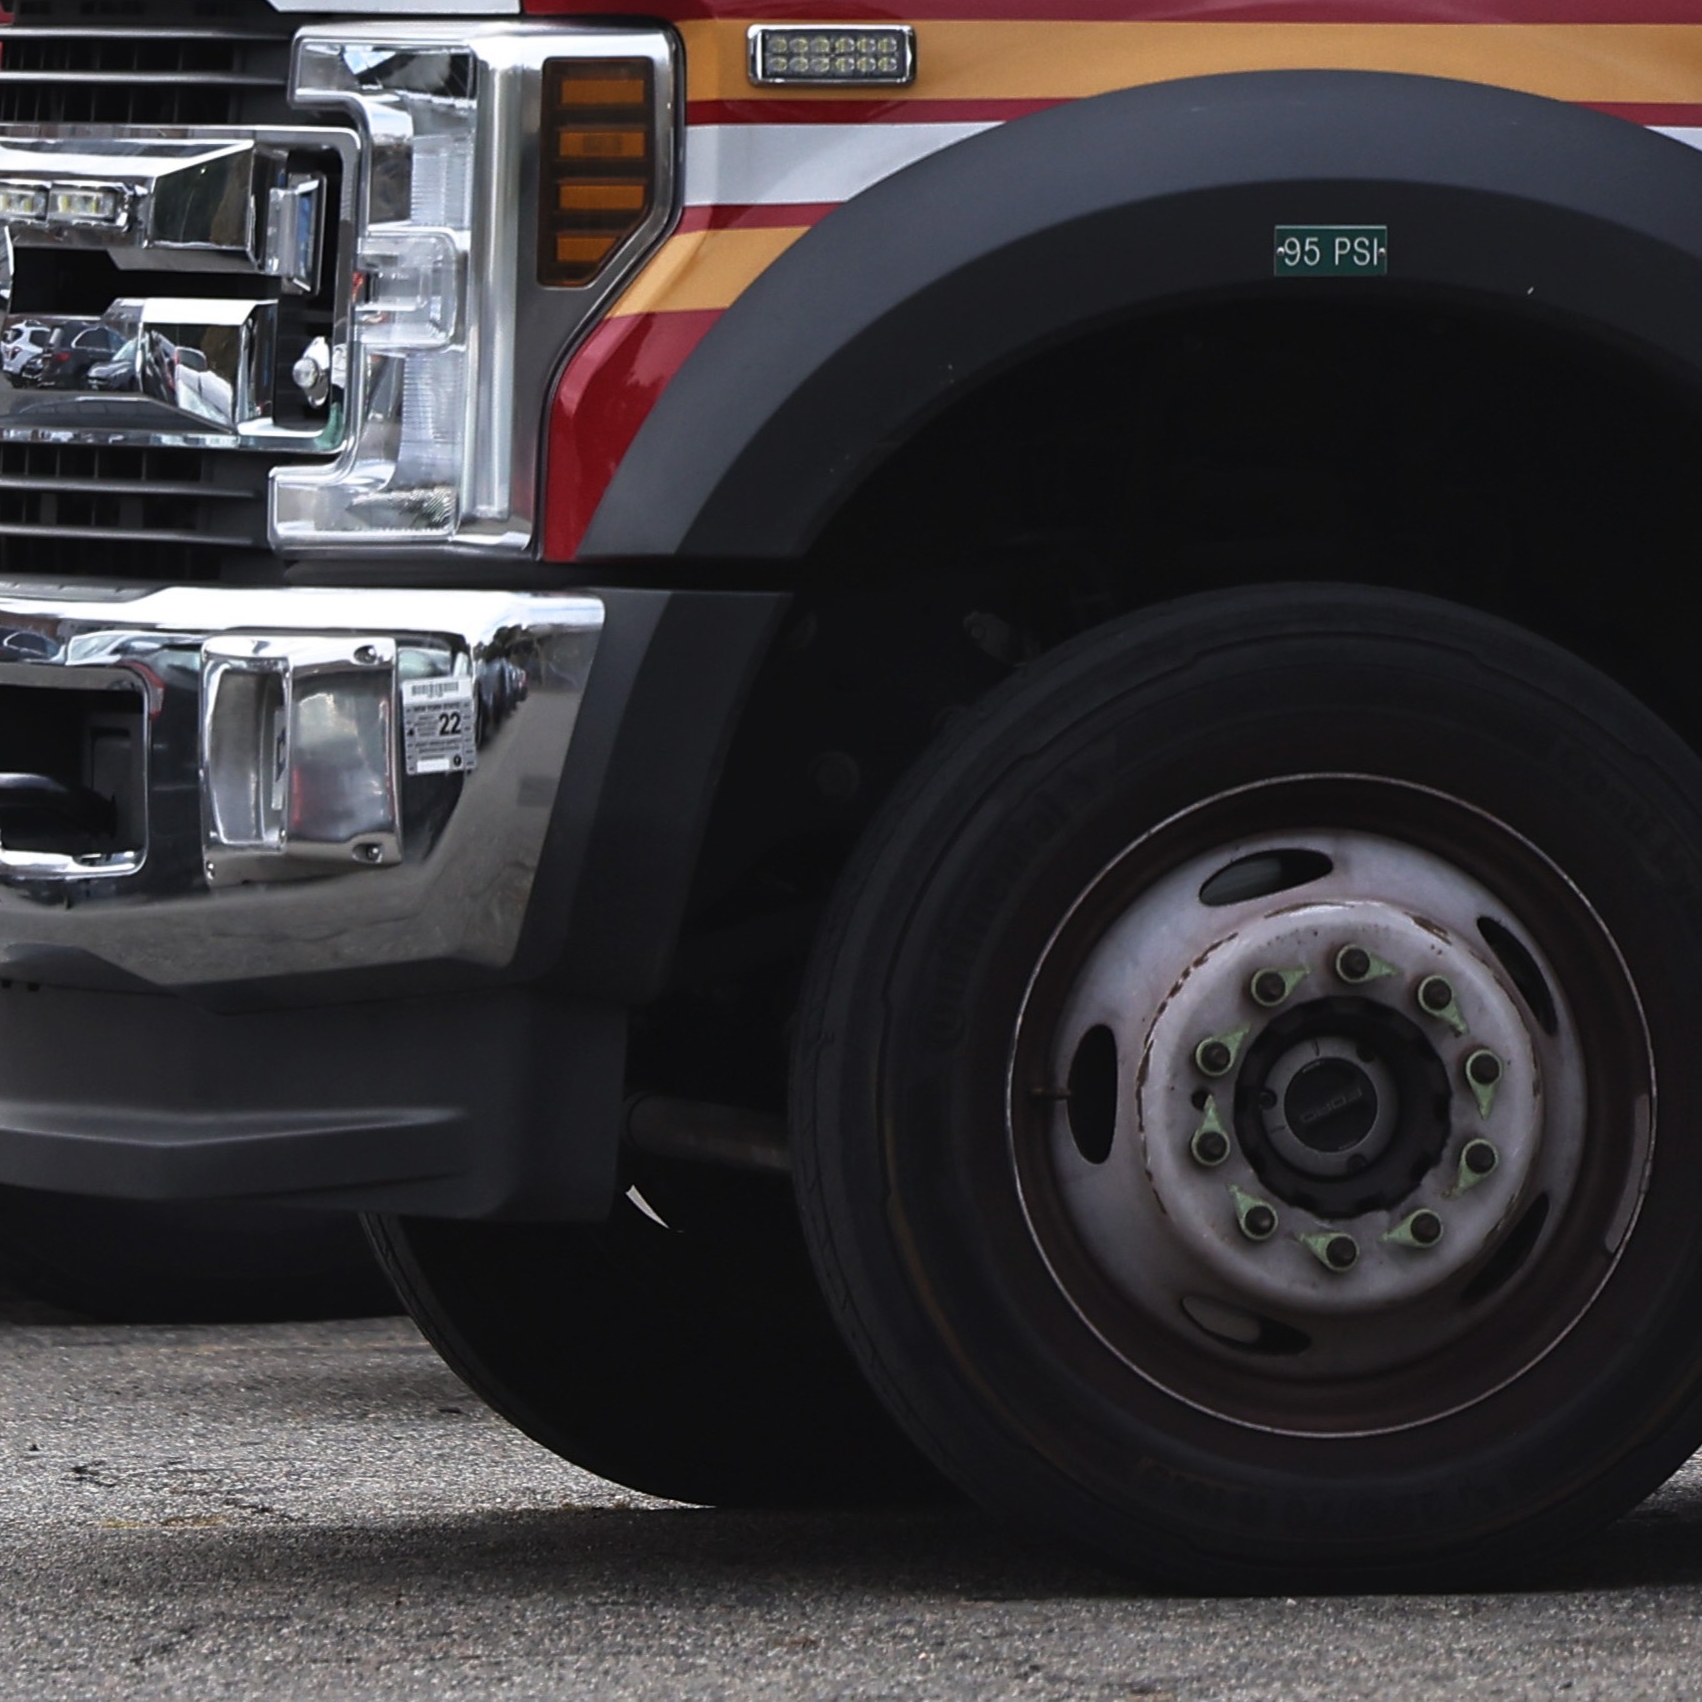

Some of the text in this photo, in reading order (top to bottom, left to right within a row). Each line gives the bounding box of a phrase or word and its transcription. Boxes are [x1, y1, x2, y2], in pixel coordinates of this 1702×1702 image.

[1283, 236, 1378, 267] 95 PSI
[439, 712, 462, 735] 22
